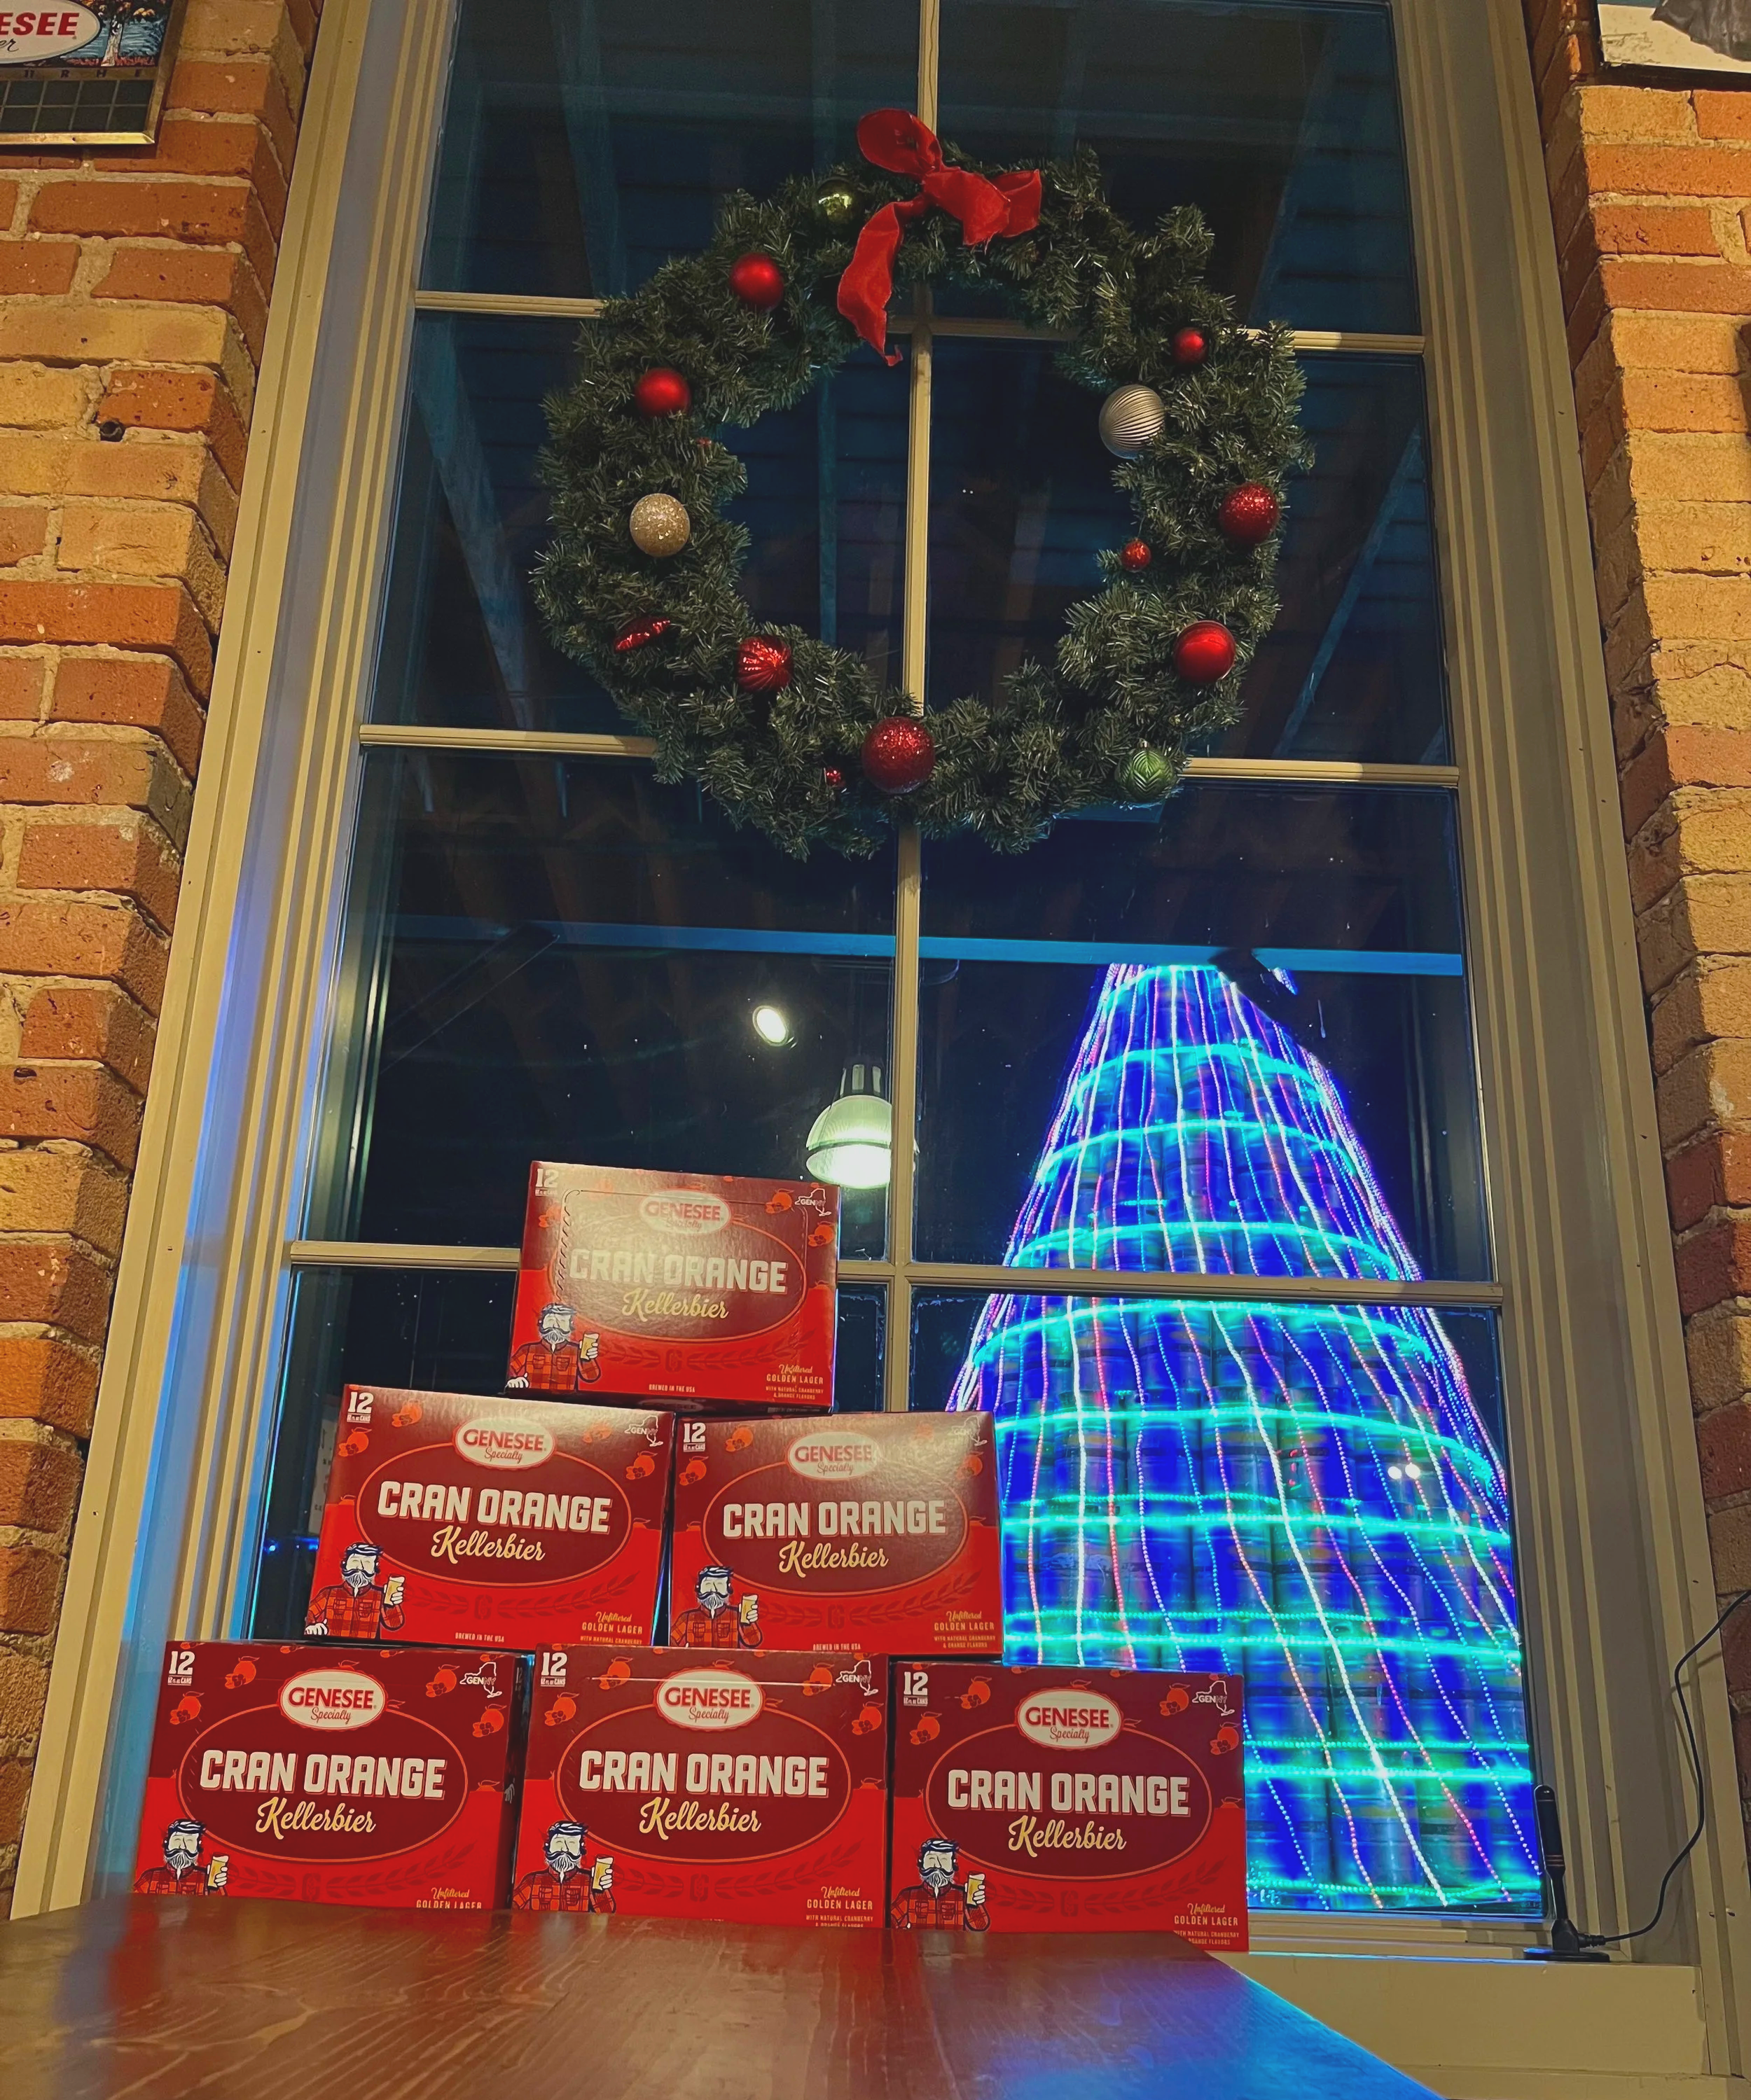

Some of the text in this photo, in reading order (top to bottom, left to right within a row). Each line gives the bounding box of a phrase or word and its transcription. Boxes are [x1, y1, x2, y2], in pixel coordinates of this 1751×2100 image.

[536, 1168, 558, 1188] 12
[646, 1200, 721, 1222] GENESEE
[569, 1249, 788, 1293] CRAN ORANGE
[622, 1288, 729, 1322] Kellerbier
[766, 1374, 824, 1384] GOLDEN LAGER
[347, 1391, 374, 1414] 12
[463, 1428, 544, 1451] GENESEE
[684, 1422, 706, 1442] 12
[485, 1447, 522, 1464] Specialty
[795, 1445, 872, 1463] GENESEE
[817, 1461, 854, 1475] Specialty
[378, 1480, 612, 1534] CRAN ORANGE
[723, 1500, 948, 1539] CRAN ORANGE
[431, 1525, 546, 1564] Kellerbier
[778, 1541, 888, 1578] Kellerbier
[582, 1622, 643, 1634] GOLDEN LAGER
[934, 1622, 995, 1631] GOLDEN LAGER
[169, 1650, 195, 1674] 12
[541, 1652, 567, 1676] 12
[466, 1676, 496, 1685] GENNY
[843, 1674, 871, 1683] GENNY
[904, 1671, 928, 1695] 12
[289, 1687, 374, 1709] GENESEE
[665, 1687, 751, 1708] GENESEE
[1198, 1695, 1227, 1704] GENNY
[310, 1706, 351, 1725] Specialty
[688, 1706, 729, 1724] Specialty
[1025, 1706, 1109, 1728] GENESEE
[1050, 1726, 1090, 1744] Specialty
[200, 1749, 446, 1800] CRAN ORANGE
[579, 1750, 829, 1798] CRAN ORANGE
[948, 1769, 1191, 1817] CRAN ORANGE
[255, 1797, 376, 1840] Kellerbier
[639, 1797, 761, 1840] Kellerbier
[1008, 1815, 1127, 1858] Kellerbier
[431, 1887, 470, 1900] Unfiltered
[821, 1886, 860, 1898] Unfiltered
[807, 1899, 873, 1910] GOLDEN LAGER
[1187, 1903, 1225, 1915] Unfiltered
[1174, 1915, 1238, 1926] GOLDEN LAGER
